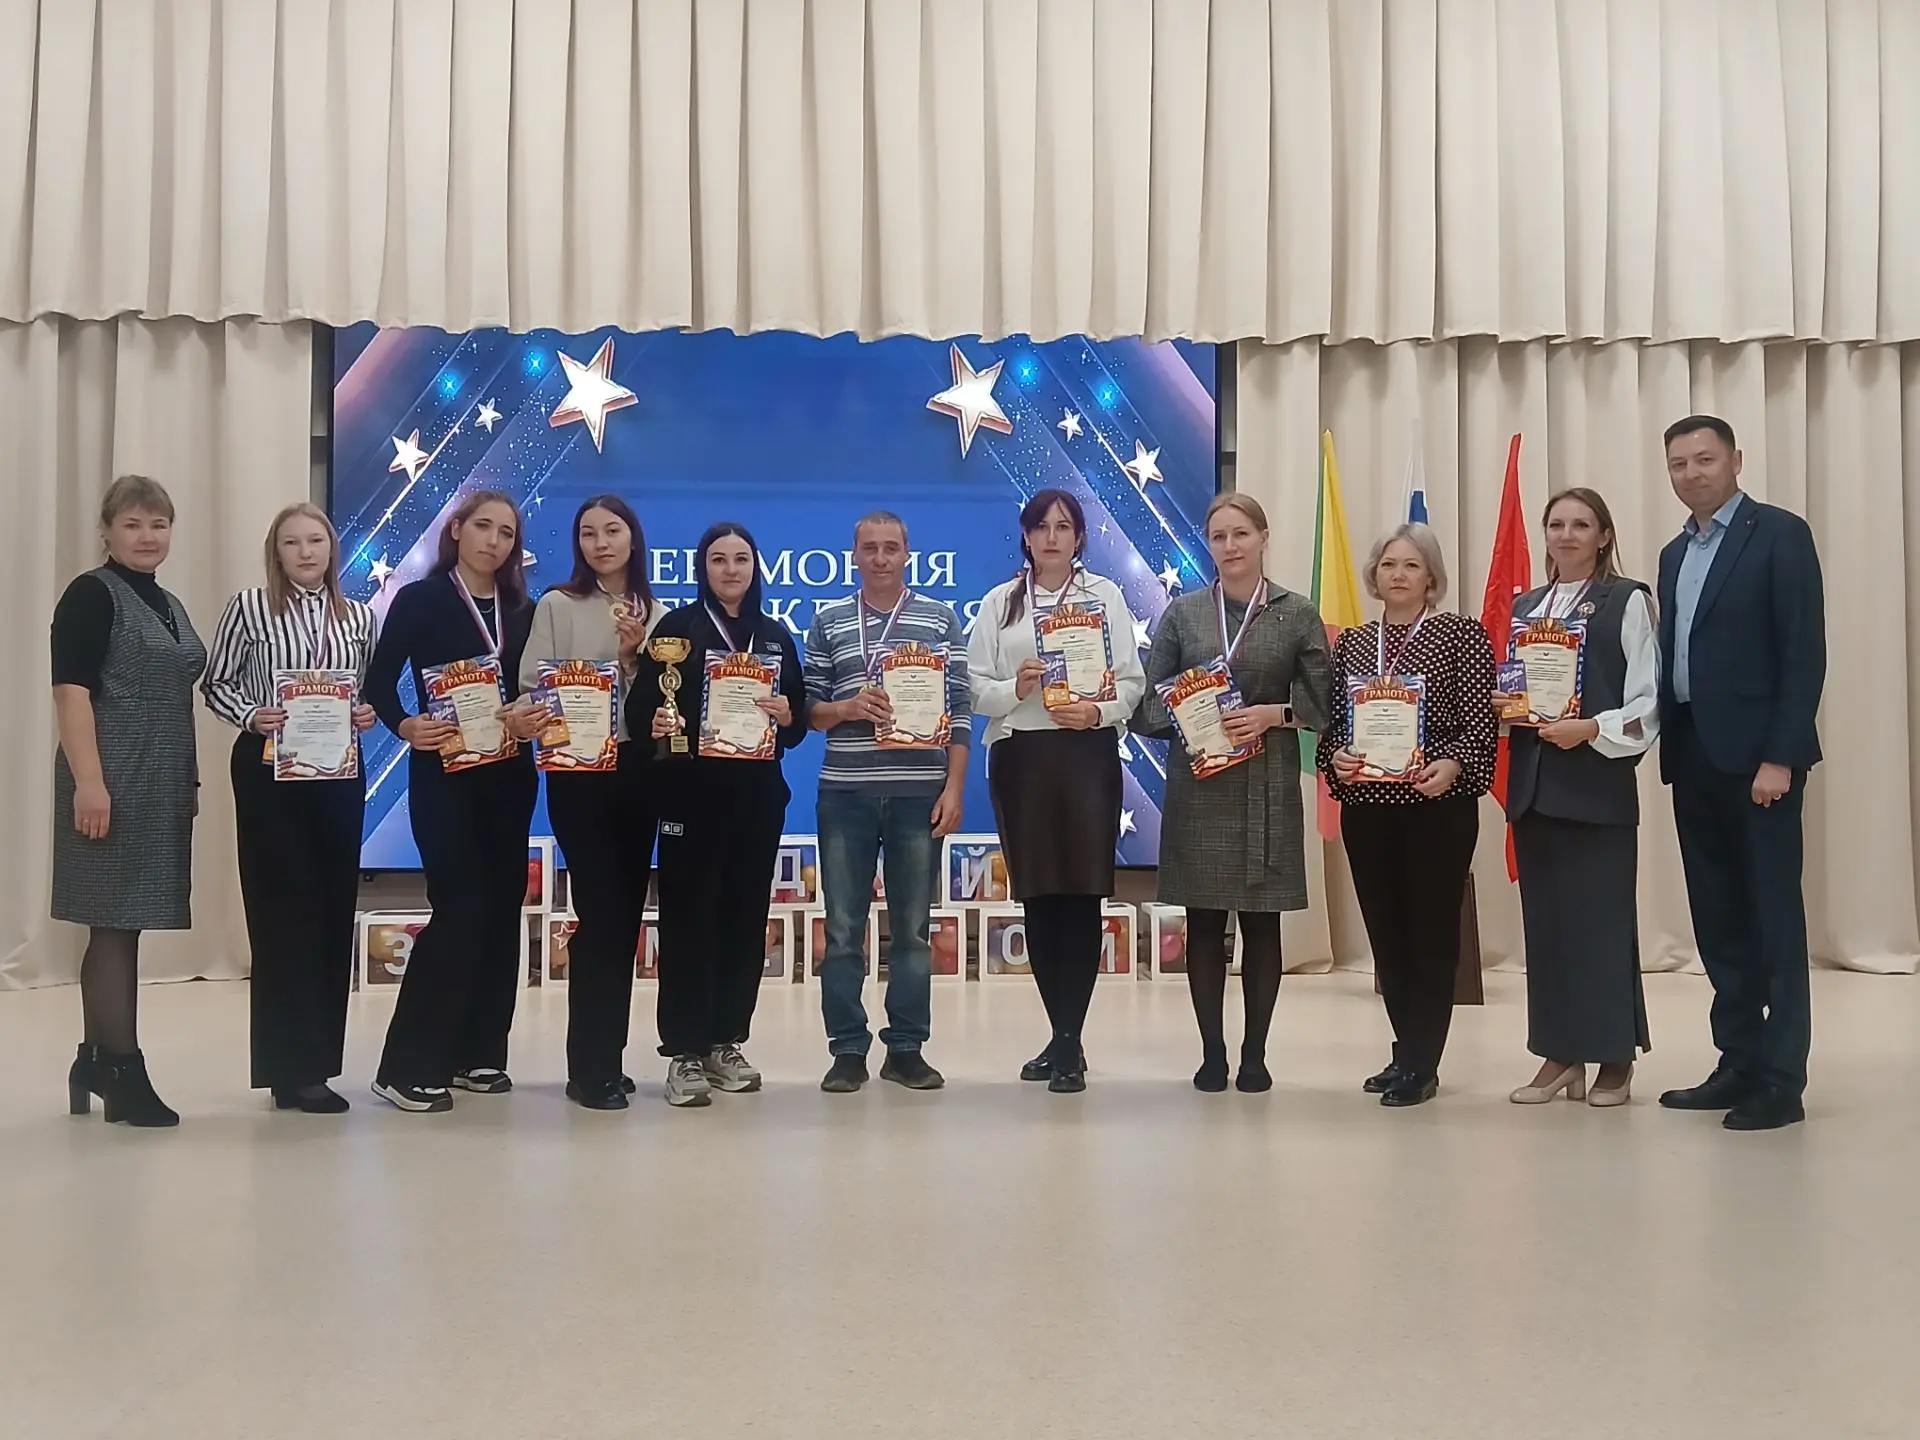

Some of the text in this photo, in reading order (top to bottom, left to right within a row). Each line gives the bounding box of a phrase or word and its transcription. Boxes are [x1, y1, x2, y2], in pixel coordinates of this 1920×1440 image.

[1049, 617, 1094, 629] ГРАМОТА
[1525, 633, 1570, 644] ГРАМОТА
[892, 656, 936, 666] ГРАМОТА
[720, 666, 765, 678] ГРАМОТА
[441, 672, 488, 689] ГРАМОТА
[555, 675, 602, 686] ГРАМОТА
[292, 684, 341, 696] ГРАМОТА
[1175, 677, 1218, 699] ГРАМОТА
[1363, 690, 1410, 699] ГРАМОТА
